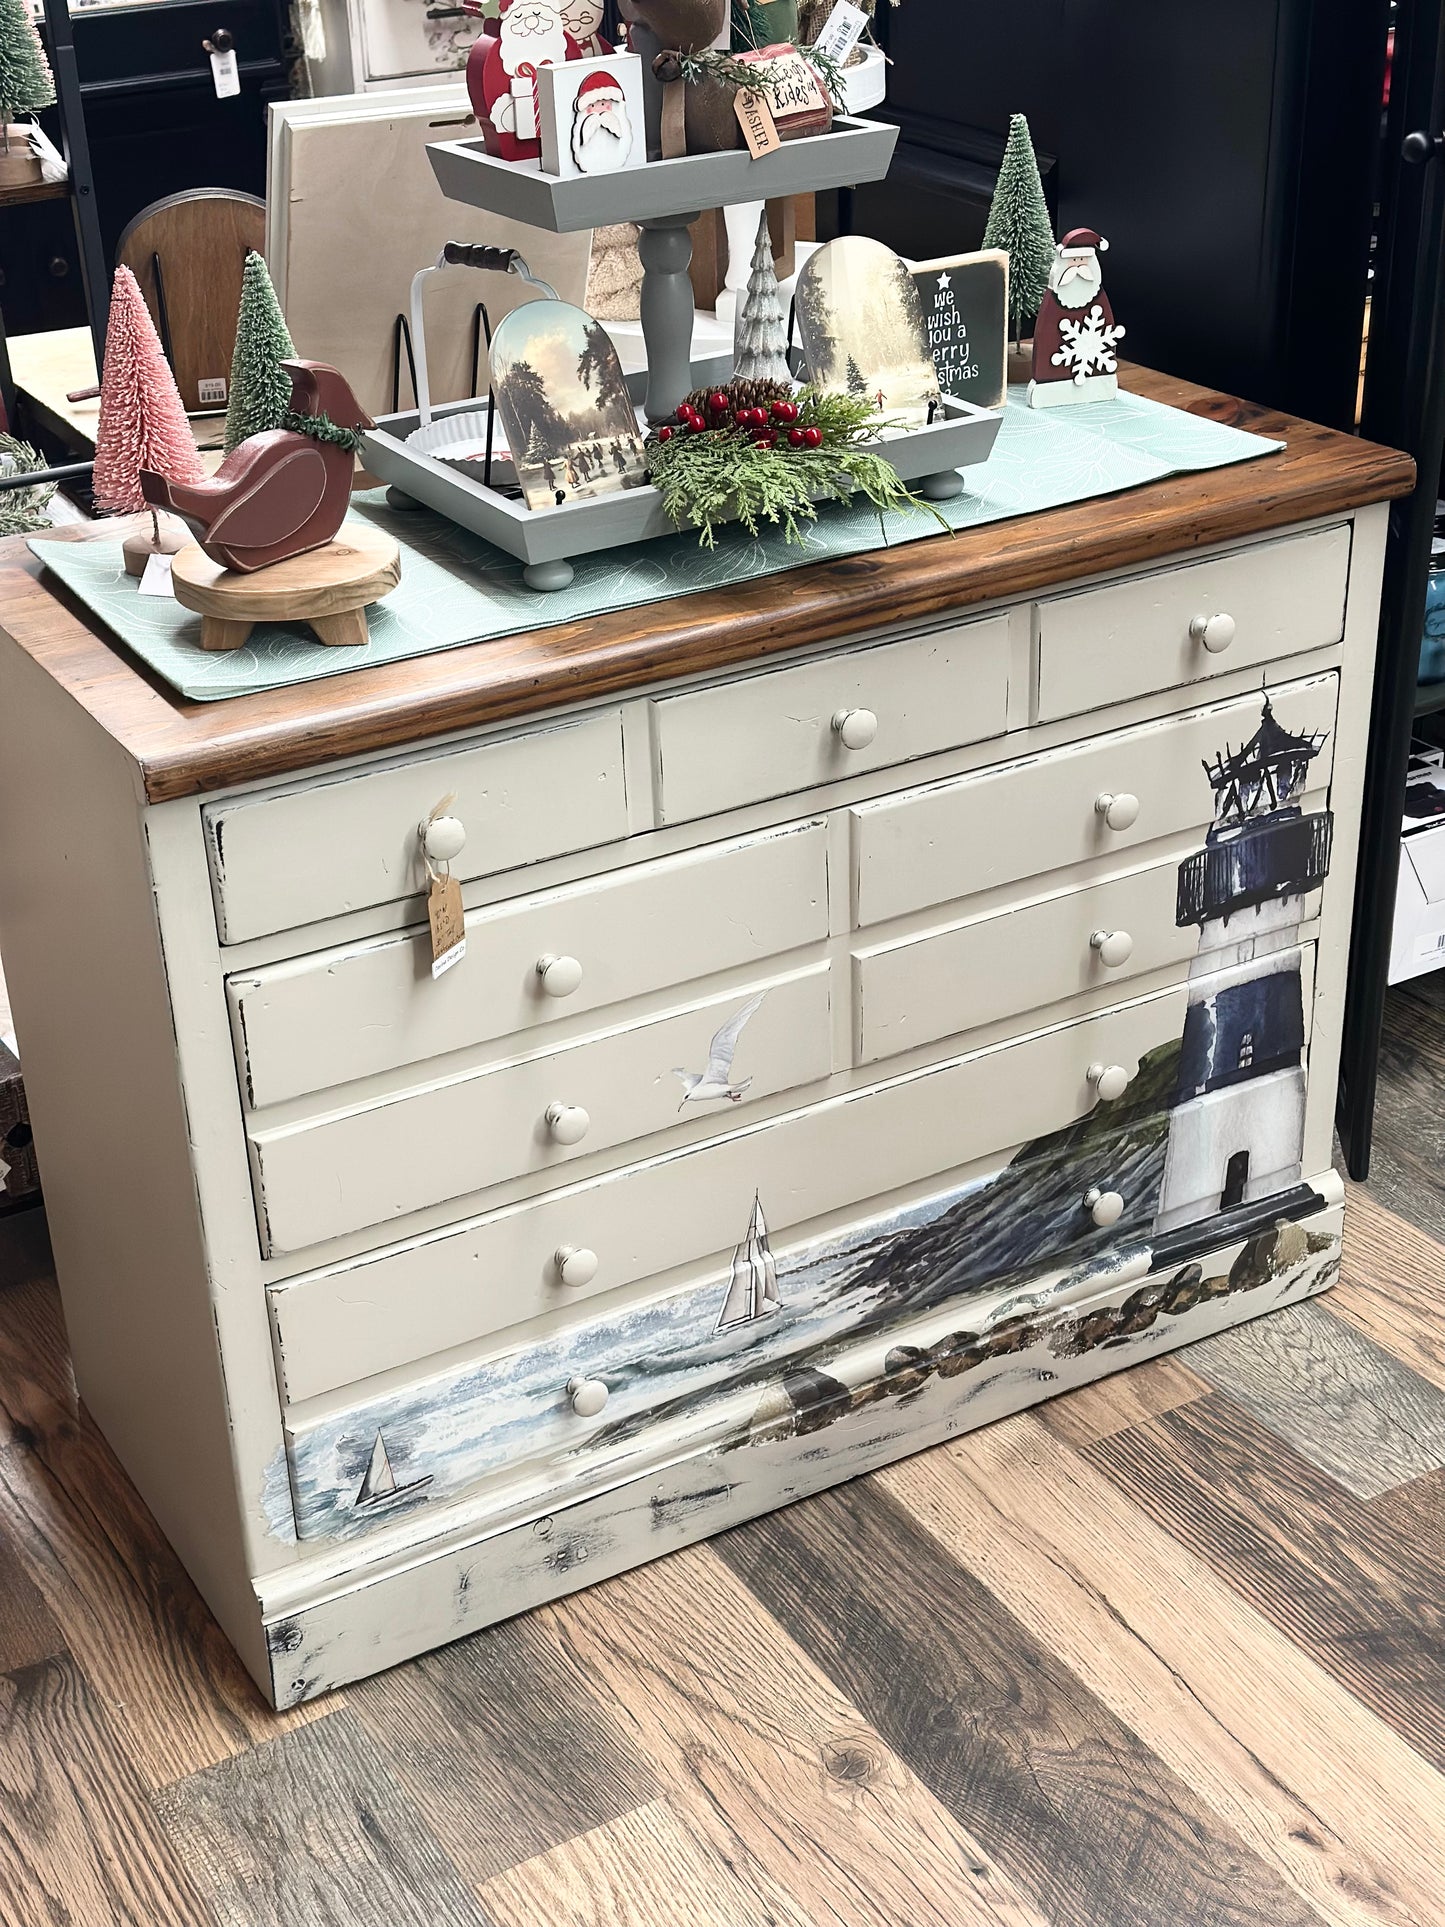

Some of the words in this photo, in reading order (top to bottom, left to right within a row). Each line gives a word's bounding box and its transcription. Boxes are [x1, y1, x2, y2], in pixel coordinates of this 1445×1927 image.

[772, 82, 809, 109] Rides
[742, 96, 769, 150] DASHER
[927, 304, 960, 330] wish
[957, 324, 966, 338] a
[932, 342, 969, 366] erry
[937, 360, 979, 387] stmas
